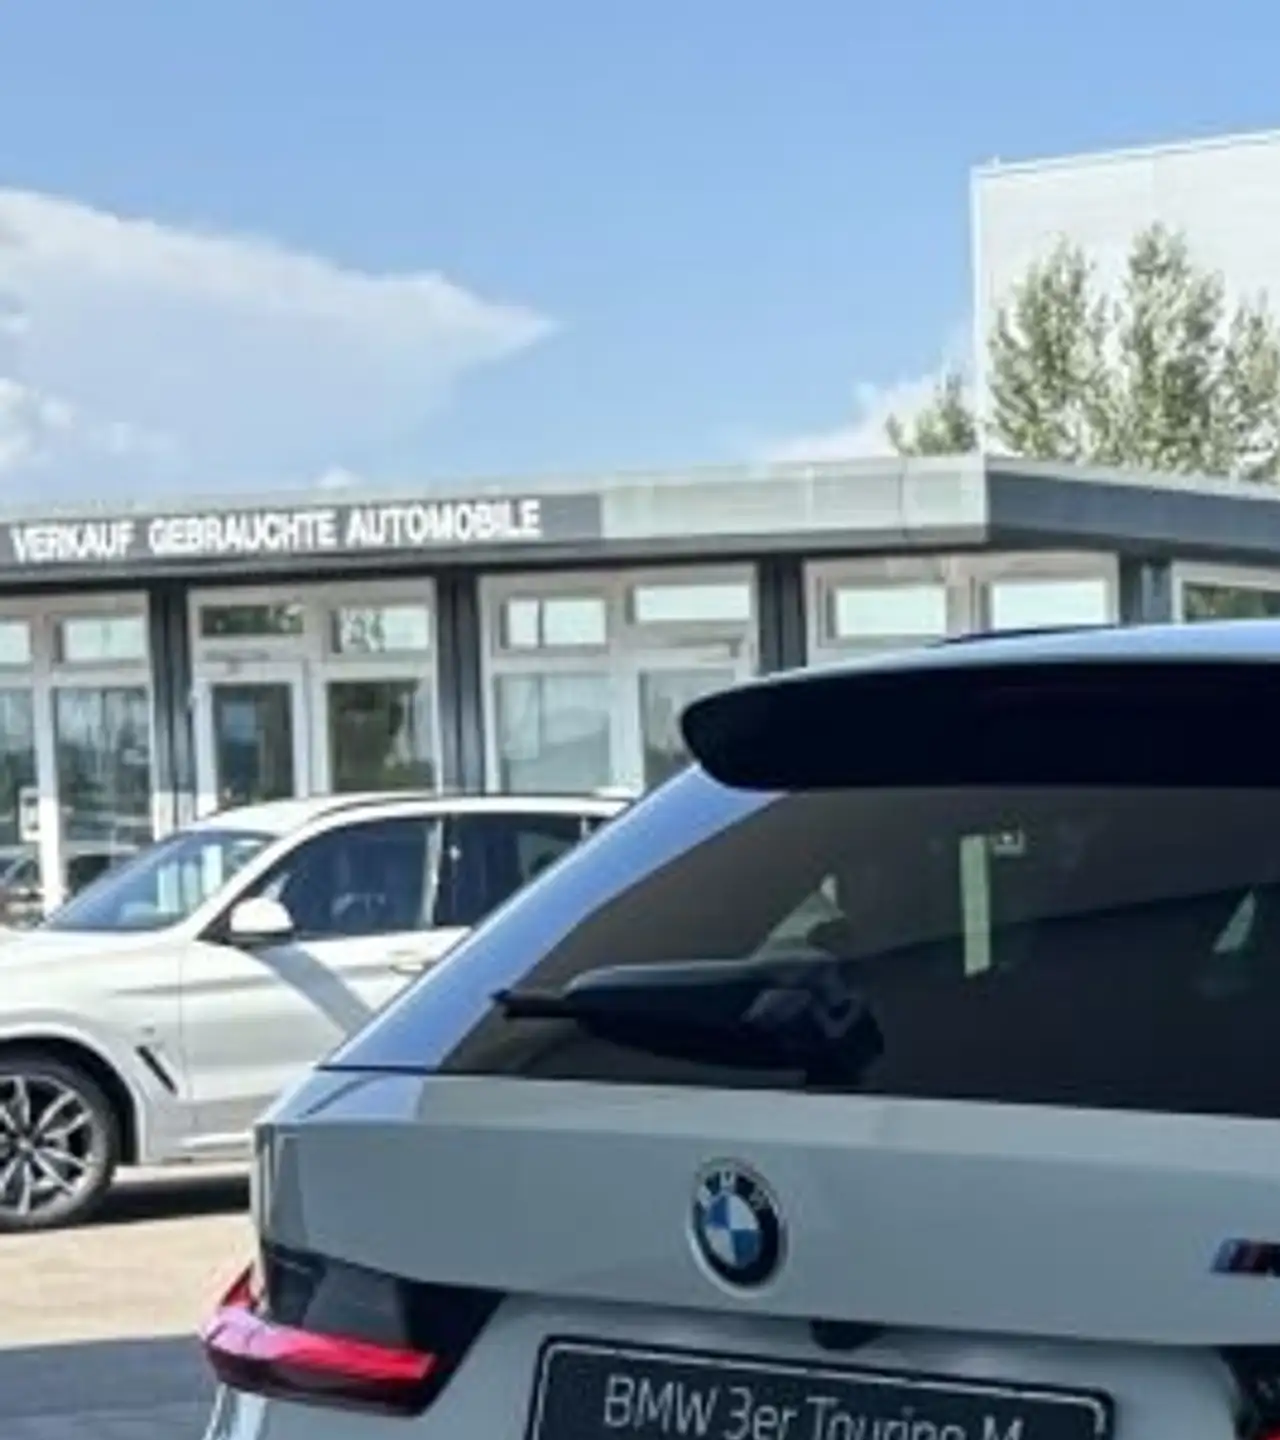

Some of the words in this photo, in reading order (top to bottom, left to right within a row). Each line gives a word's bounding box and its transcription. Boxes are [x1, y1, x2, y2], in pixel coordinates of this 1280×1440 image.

[9, 519, 136, 564] VERKAUF
[148, 509, 338, 557] GEBRAUCHTE
[346, 499, 542, 550] AUTOMOBILE
[603, 1374, 718, 1437] BMW
